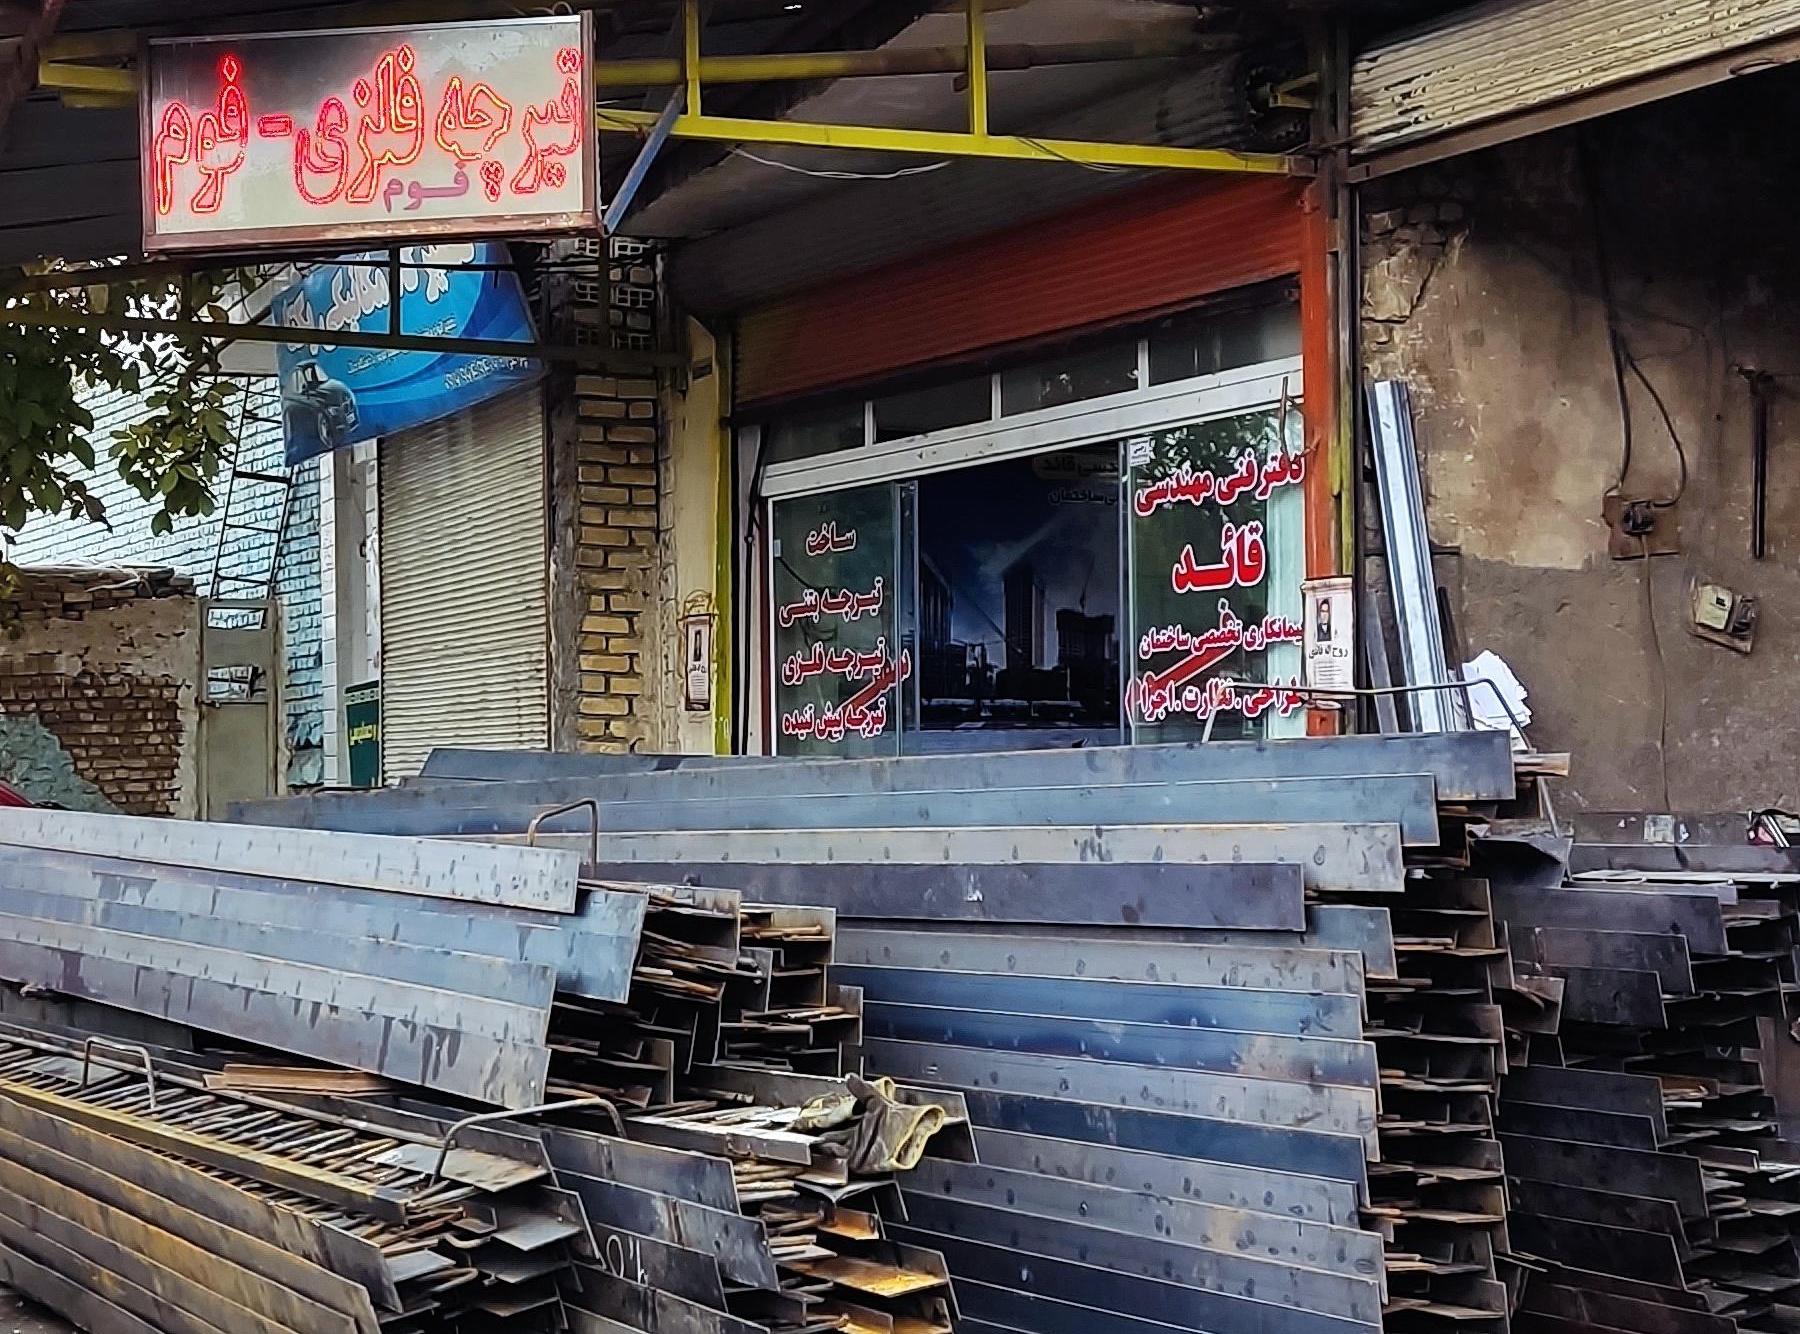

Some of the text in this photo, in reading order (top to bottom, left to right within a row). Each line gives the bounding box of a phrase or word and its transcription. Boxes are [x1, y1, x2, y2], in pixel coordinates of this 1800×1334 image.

[153, 53, 251, 216] فوم
[294, 43, 425, 207] فلزی
[434, 46, 584, 202] تیرچه
[383, 160, 469, 213] فوم
[1135, 448, 1305, 516] دفتر فنی مهندسی
[806, 520, 857, 556] ساخت
[1172, 520, 1266, 594] قائد
[779, 576, 884, 628] تیرچه بتنی
[826, 636, 886, 682] تیرچه
[1139, 613, 1302, 659] یمانکاری تخصصی ساختمان
[782, 641, 826, 686] فلزی
[845, 697, 887, 739] تیرچه
